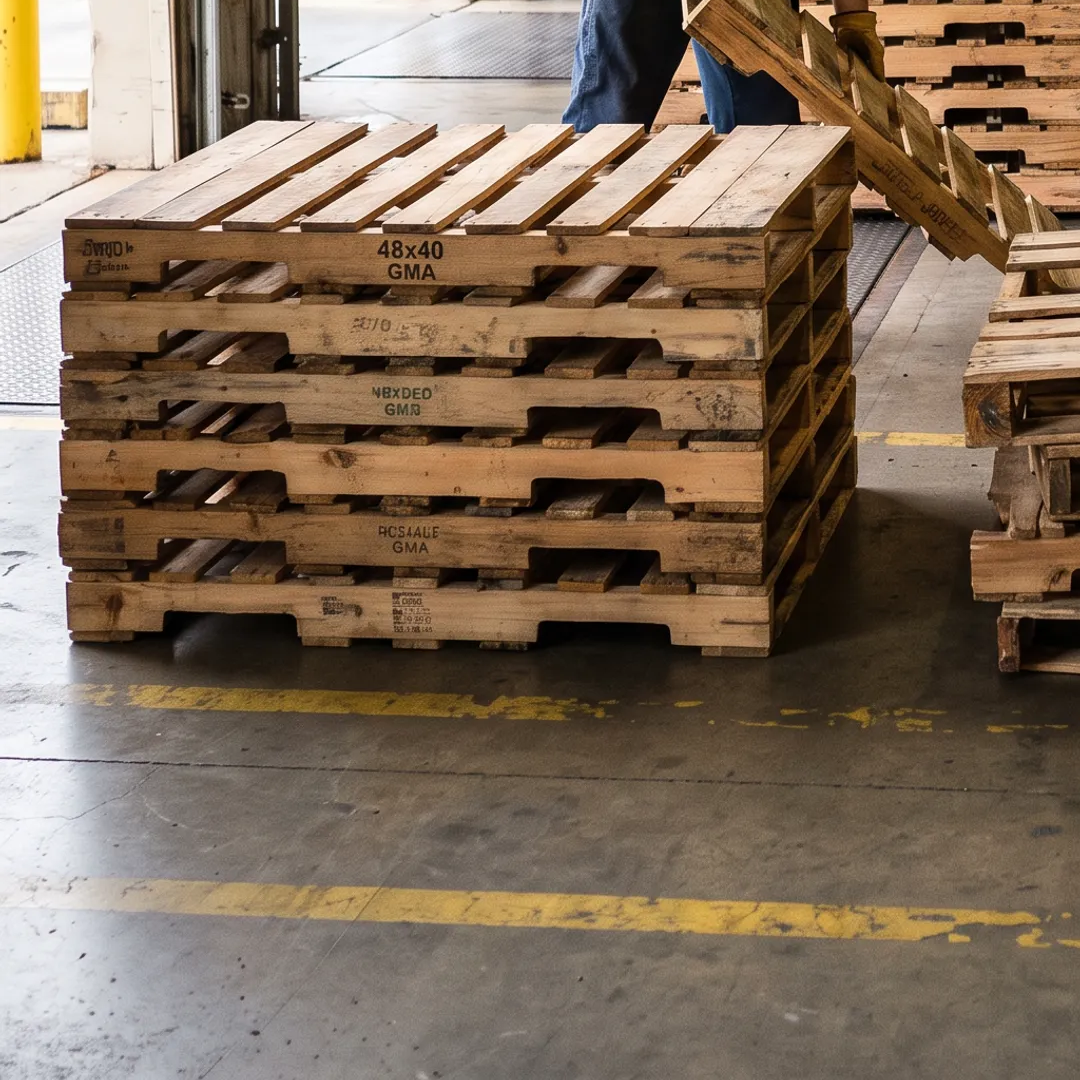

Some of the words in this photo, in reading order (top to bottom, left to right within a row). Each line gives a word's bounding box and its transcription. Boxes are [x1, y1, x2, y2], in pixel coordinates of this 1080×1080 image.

[377, 239, 444, 260] 48x40
[387, 263, 437, 281] GMA
[392, 541, 429, 554] GMA
